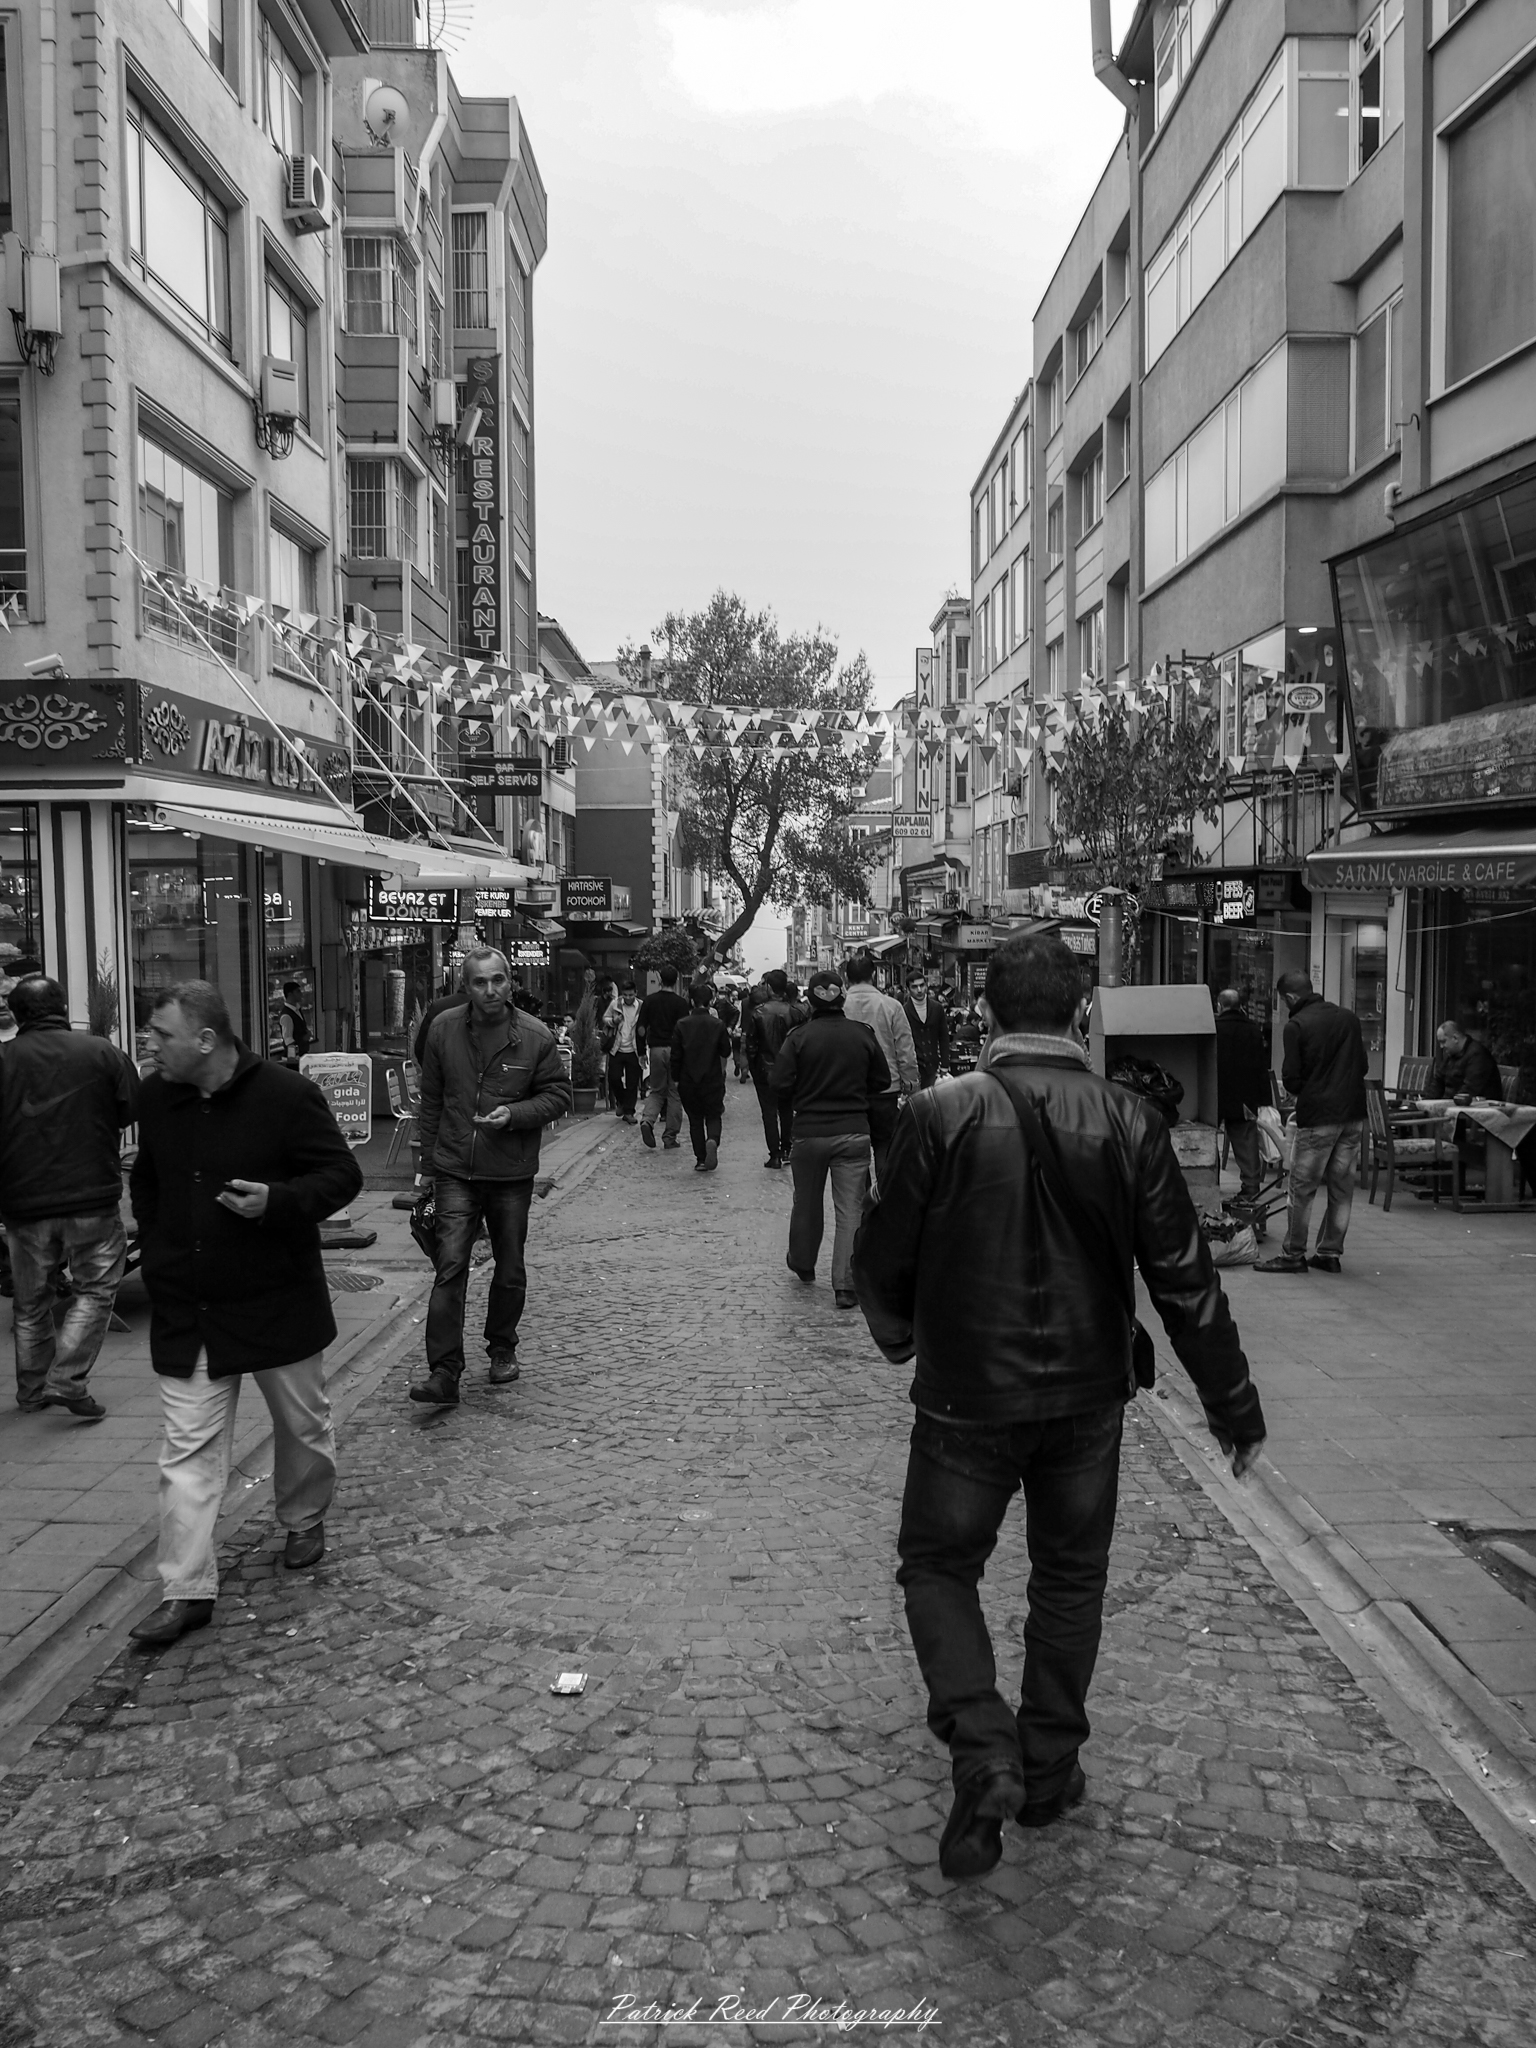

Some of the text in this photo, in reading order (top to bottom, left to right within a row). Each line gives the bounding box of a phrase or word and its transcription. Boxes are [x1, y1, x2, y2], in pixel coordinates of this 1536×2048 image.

[472, 437, 496, 649] RESTAURANT
[202, 714, 267, 782] AZİZ
[918, 672, 930, 809] YASMIN
[470, 772, 539, 786] SELF SERVİS
[894, 816, 930, 827] KAPLAMA
[1335, 861, 1516, 885] SARNIÇ NARGİLE & CAFE
[567, 880, 604, 892] KIRTASİYE
[1223, 880, 1243, 899] EFES
[378, 891, 425, 905] BEYAZ
[428, 892, 447, 906] ET
[490, 891, 510, 900] KURU
[566, 894, 606, 906] FOTOKOPİ
[385, 903, 438, 919] DÖNER
[1223, 902, 1243, 919] BEER
[333, 1087, 360, 1098] gıda
[336, 1111, 367, 1121] Food
